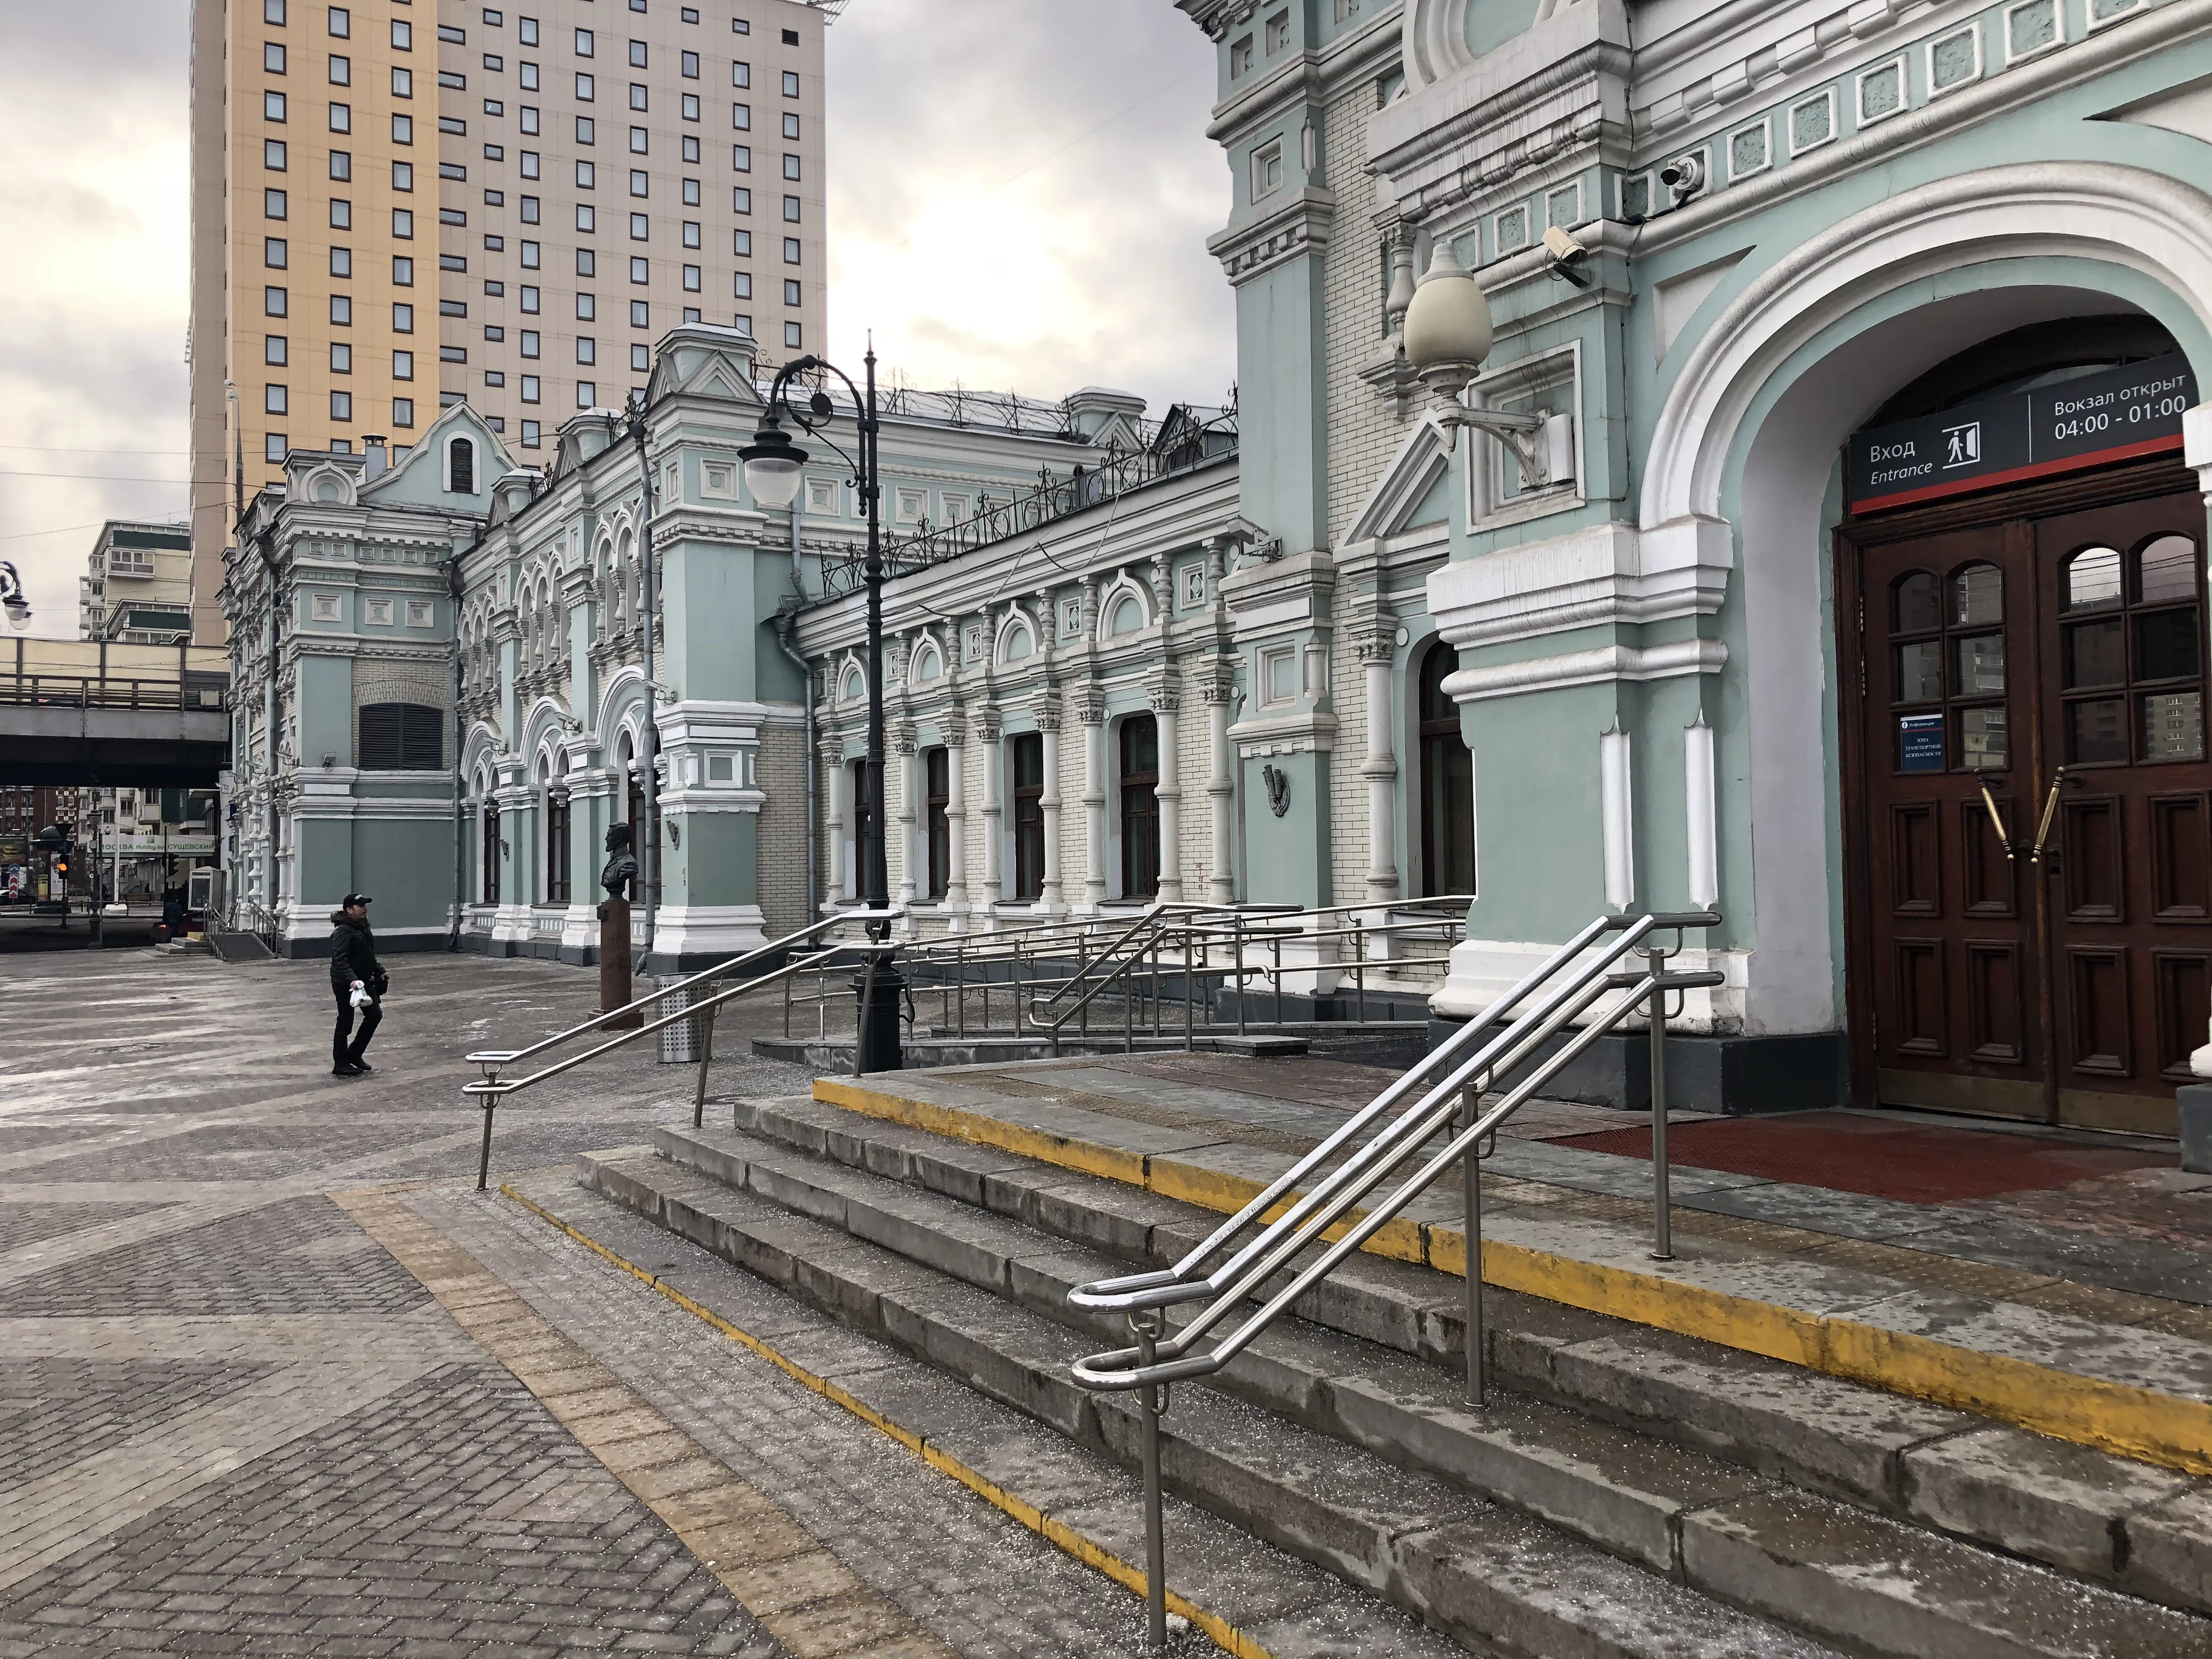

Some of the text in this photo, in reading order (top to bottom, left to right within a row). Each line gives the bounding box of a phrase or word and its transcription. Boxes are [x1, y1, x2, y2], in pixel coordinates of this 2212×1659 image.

[2055, 375, 2186, 416] Вокзал открыт
[2055, 413, 2109, 440] 04:00
[2129, 394, 2187, 424] 01:00
[1871, 441, 1915, 462] Вход
[1871, 462, 1933, 485] Entrance
